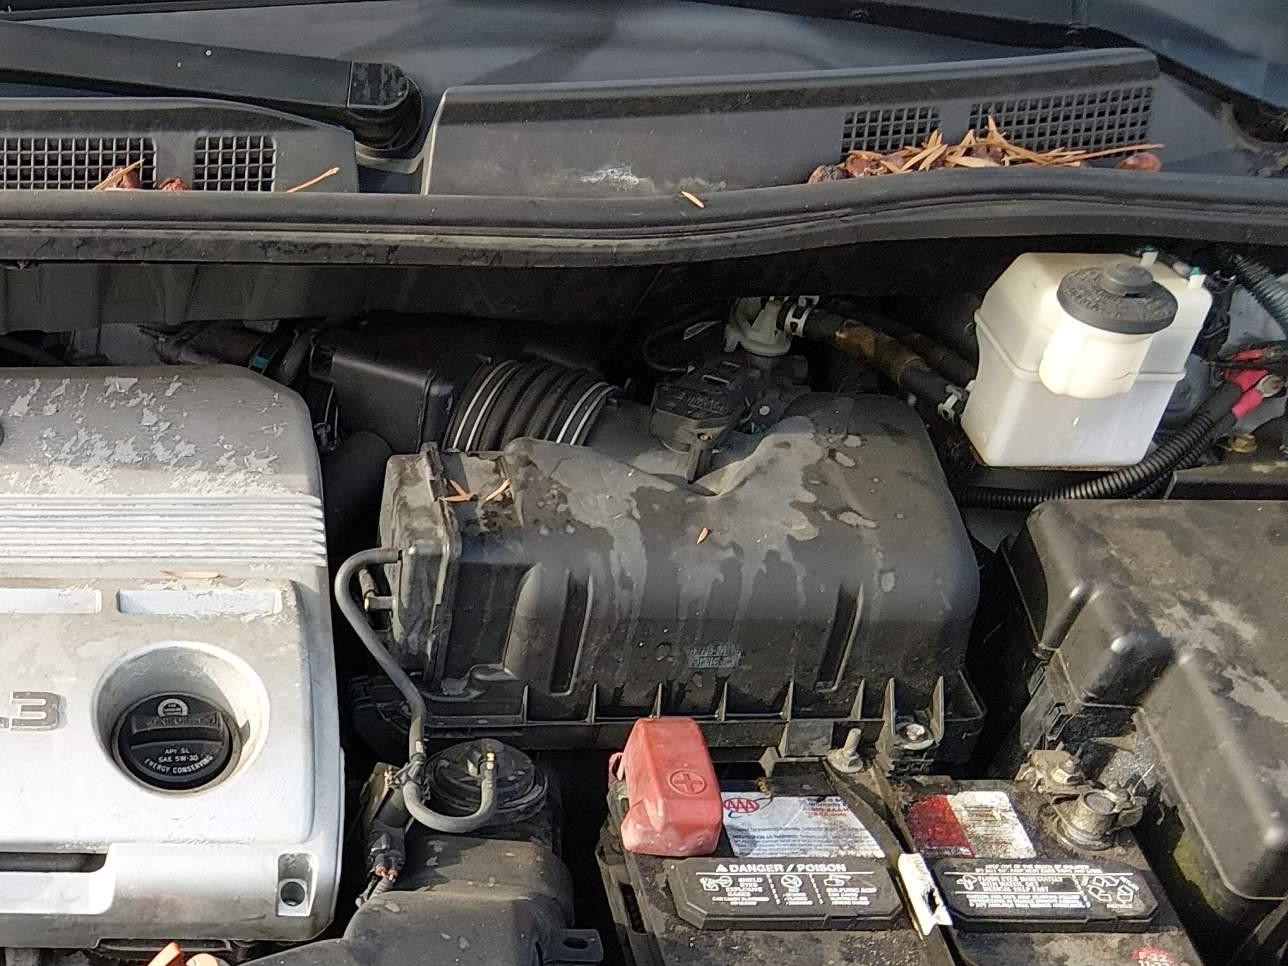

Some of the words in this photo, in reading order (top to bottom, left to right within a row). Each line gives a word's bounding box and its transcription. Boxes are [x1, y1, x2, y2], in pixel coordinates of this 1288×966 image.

[144, 758, 171, 773] ENERGY
[724, 798, 758, 811] AAA
[728, 864, 784, 872] DANGER
[797, 864, 847, 872] POISON
